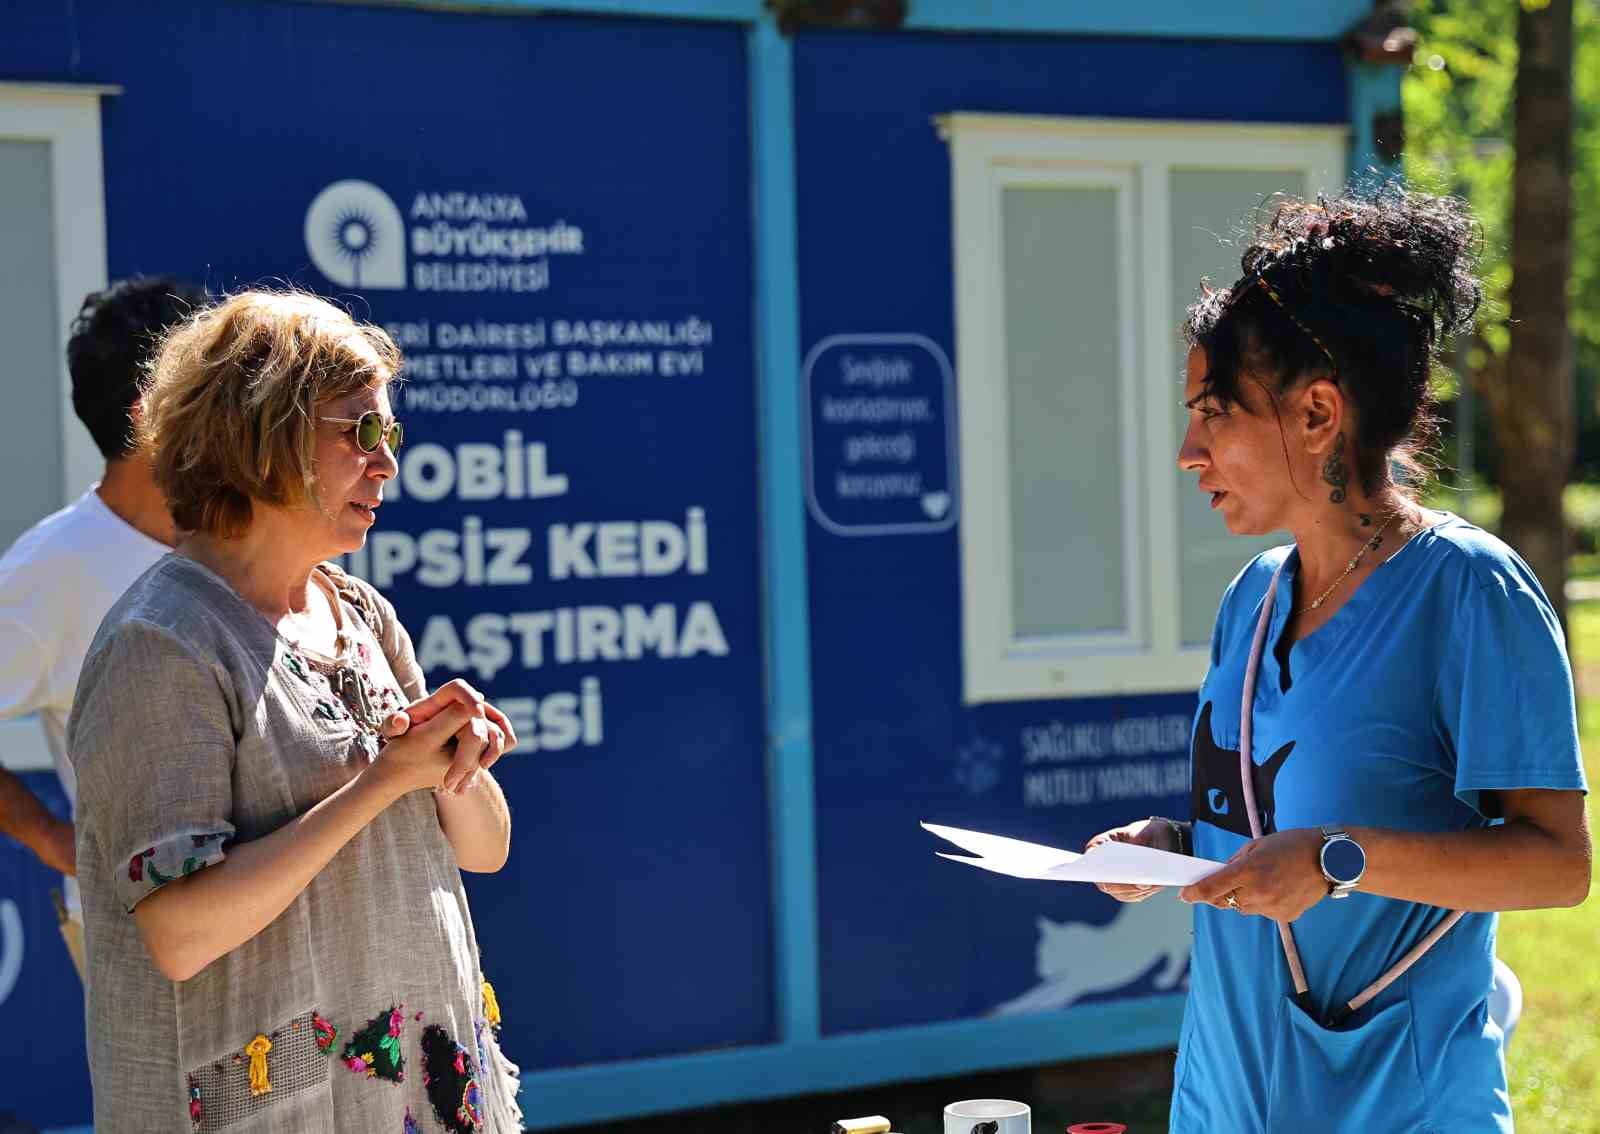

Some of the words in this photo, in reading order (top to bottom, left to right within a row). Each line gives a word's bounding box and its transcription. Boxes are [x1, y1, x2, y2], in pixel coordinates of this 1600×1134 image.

[411, 192, 528, 222] ANTALYA
[412, 220, 584, 258] BÜYÜKŞEHİR
[414, 259, 549, 292] BELEDİYESİ
[436, 318, 546, 349] DAİRESİ
[552, 315, 713, 348] BAŞKANLIĞI
[524, 350, 560, 379] VE
[567, 350, 653, 377] BAKIM
[658, 348, 704, 377] EVİ
[405, 377, 578, 412] MÜDÜRLÜĞÜ
[383, 430, 568, 501] OBİL
[548, 506, 709, 580] KEDİ
[418, 602, 729, 680] AŞTIRMA
